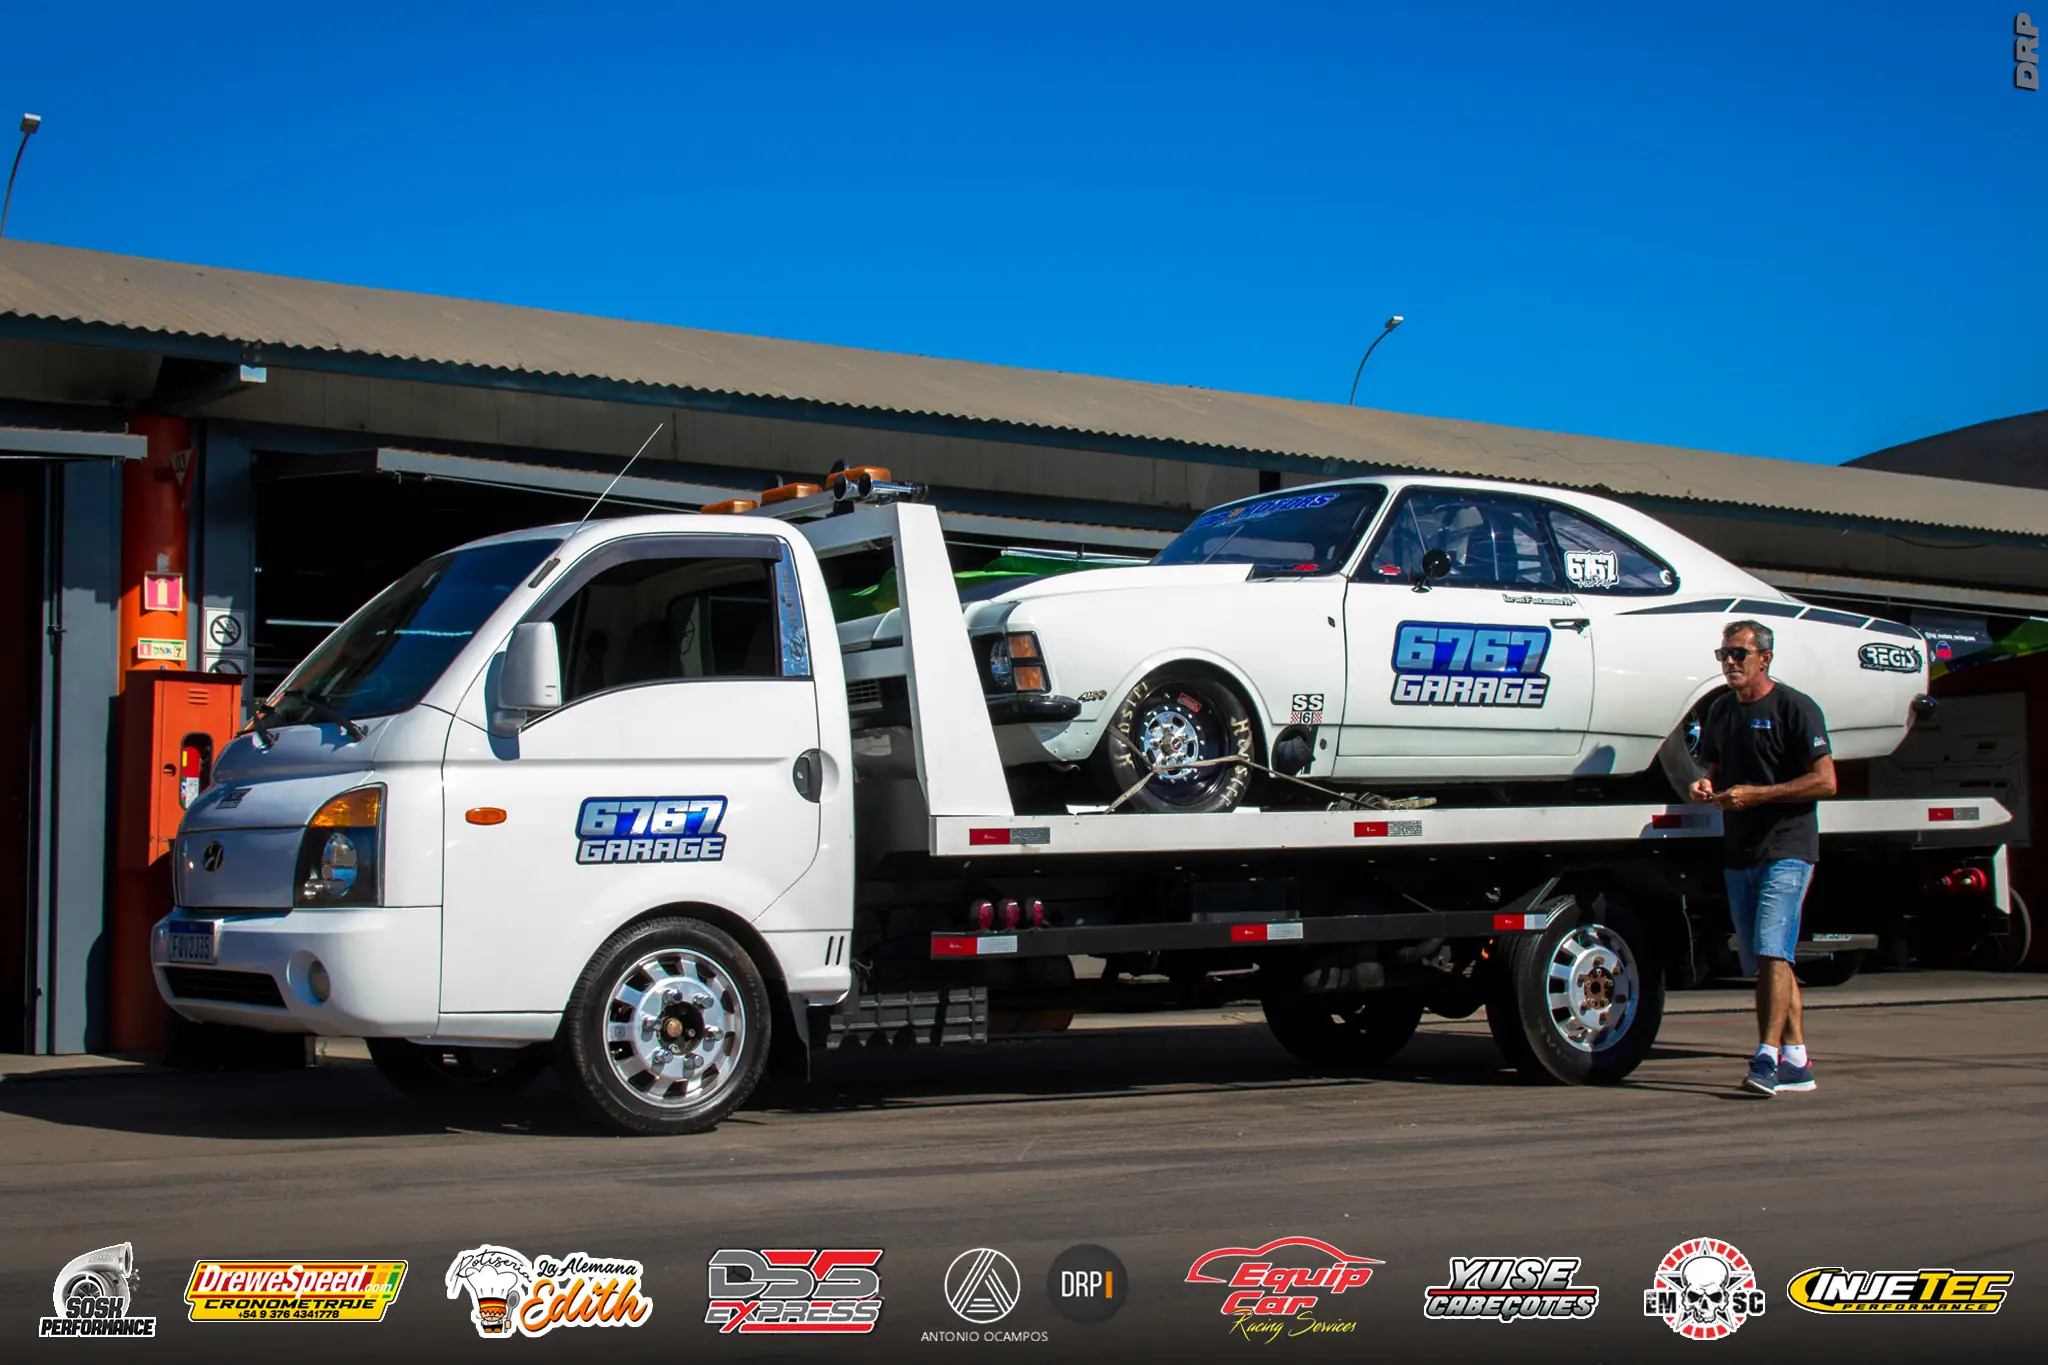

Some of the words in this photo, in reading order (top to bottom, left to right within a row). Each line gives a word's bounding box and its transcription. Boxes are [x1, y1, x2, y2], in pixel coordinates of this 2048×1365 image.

[175, 647, 182, 658] 7
[1396, 626, 1548, 674] 6767
[1393, 674, 1548, 704] GARAGE
[1292, 693, 1324, 712] SS
[1302, 712, 1312, 724] 6
[580, 800, 724, 836] 6767
[578, 837, 725, 862] GARAGE
